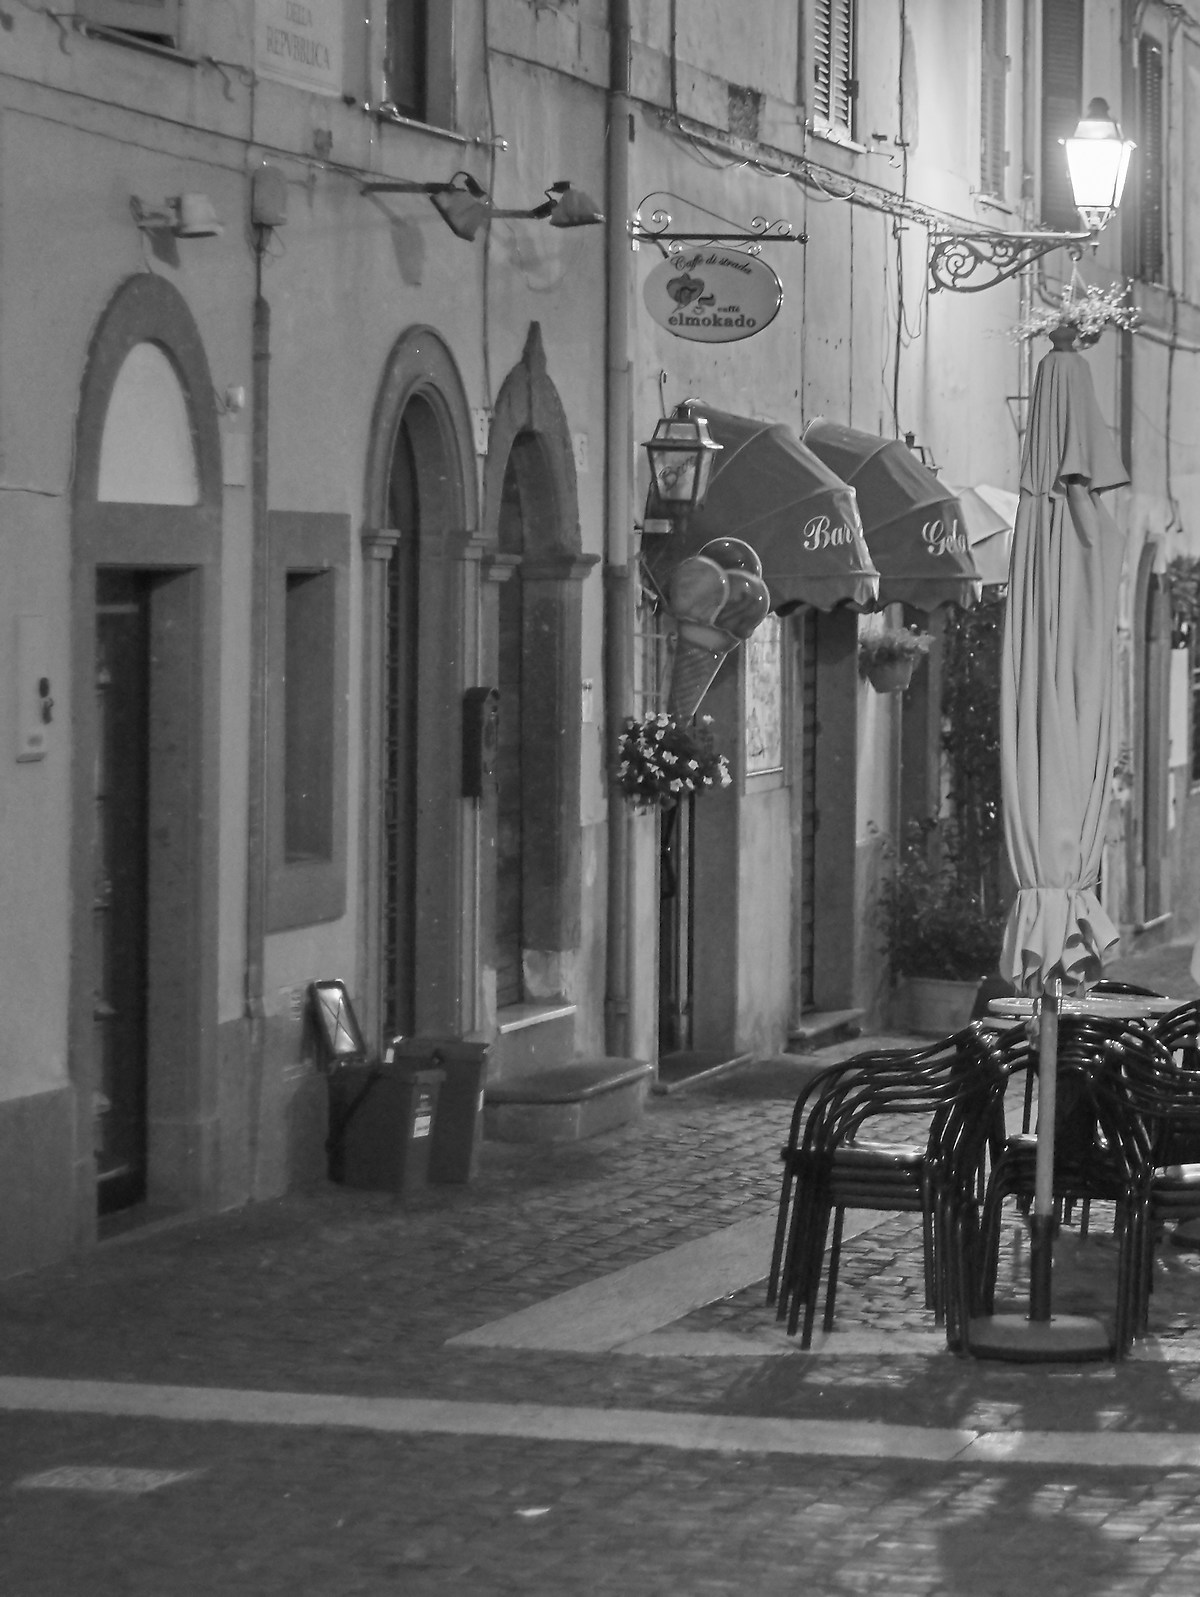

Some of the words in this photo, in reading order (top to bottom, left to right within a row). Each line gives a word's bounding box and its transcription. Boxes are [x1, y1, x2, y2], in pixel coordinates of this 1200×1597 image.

[705, 253, 719, 265] di
[719, 257, 753, 275] strada
[668, 313, 757, 328] elmokado
[803, 515, 853, 551] Bar
